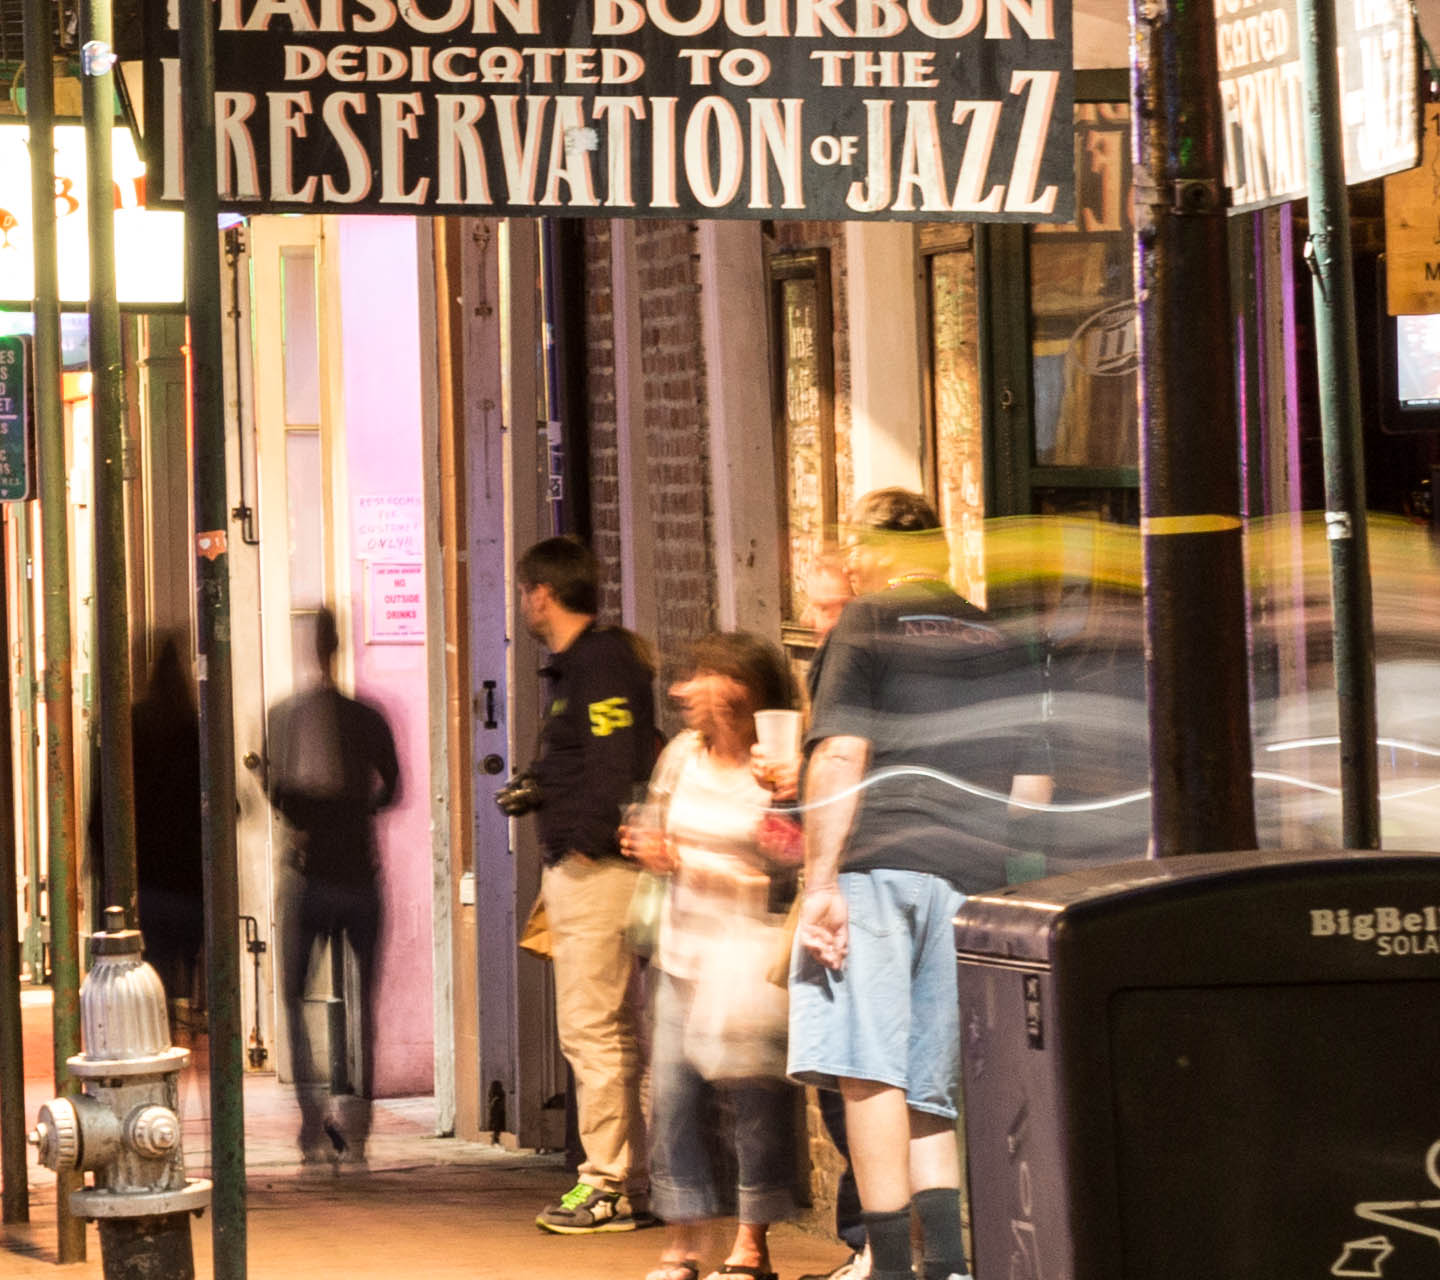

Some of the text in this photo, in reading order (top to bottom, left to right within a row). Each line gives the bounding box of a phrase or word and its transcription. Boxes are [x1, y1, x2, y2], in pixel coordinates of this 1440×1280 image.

[283, 44, 940, 88] DEDICATED TO THE
[810, 136, 859, 166] OF
[846, 70, 1060, 213] JAZZ
[384, 594, 420, 604] OUTSIDE
[386, 610, 416, 619] DRINKS
[1310, 906, 1440, 940] BigBel
[1377, 934, 1440, 956] SOLA
